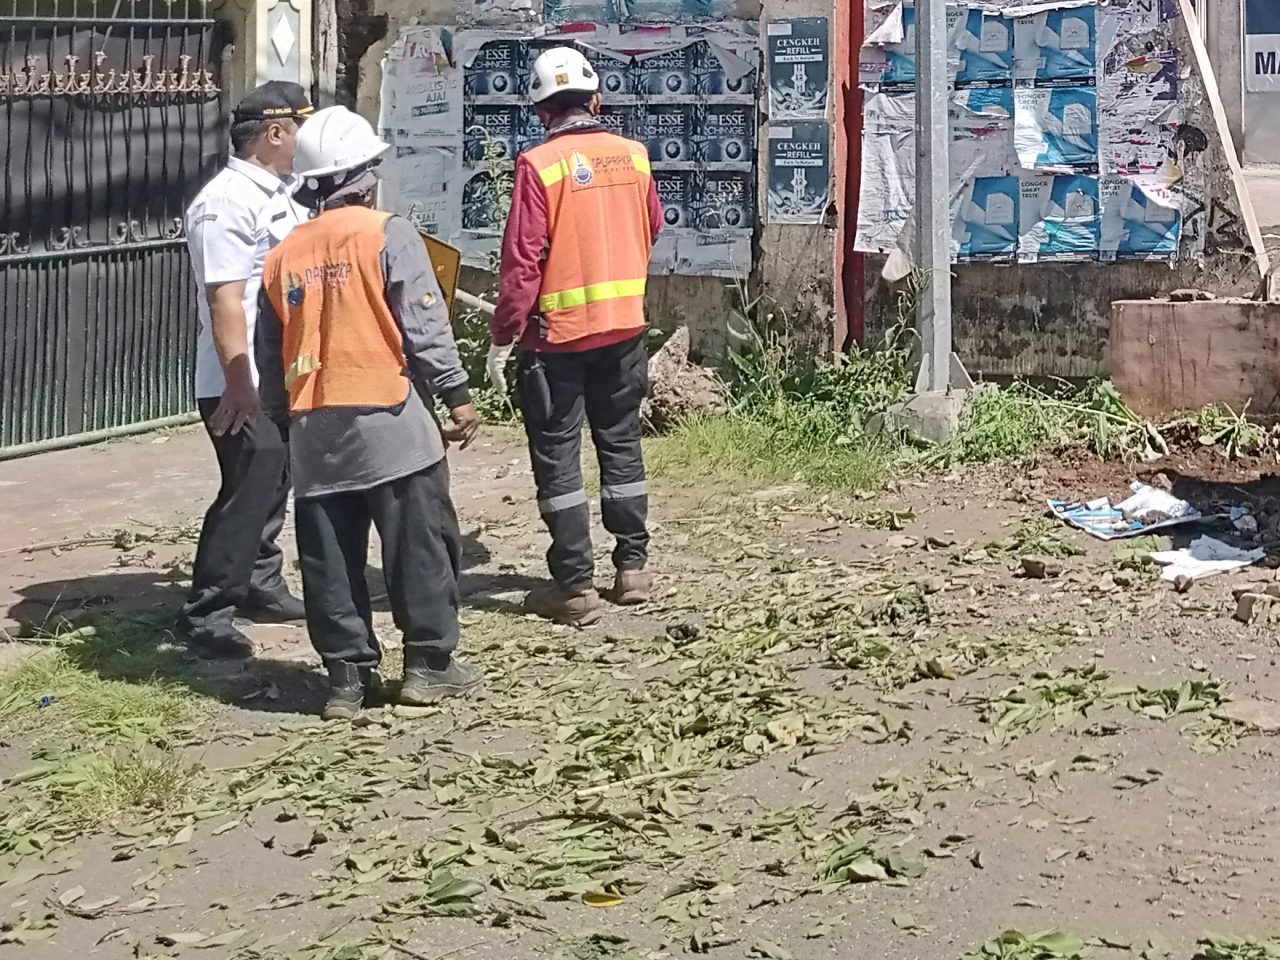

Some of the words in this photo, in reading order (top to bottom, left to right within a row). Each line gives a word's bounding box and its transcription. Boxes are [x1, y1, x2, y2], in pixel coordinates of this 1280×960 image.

[777, 37, 820, 47] CENGKEH
[485, 49, 511, 60] ESSE
[786, 47, 811, 55] REFILL
[648, 59, 686, 68] CHANGE
[485, 114, 511, 126] ESSE
[599, 114, 625, 126] ESSE
[658, 114, 685, 126] ESSE
[719, 114, 746, 126] ESSE
[647, 126, 685, 135] CHANGE
[707, 126, 745, 135] CHANGE
[777, 142, 821, 151] CENGKEH
[786, 151, 811, 159] REFILL
[657, 180, 684, 192] ESSE
